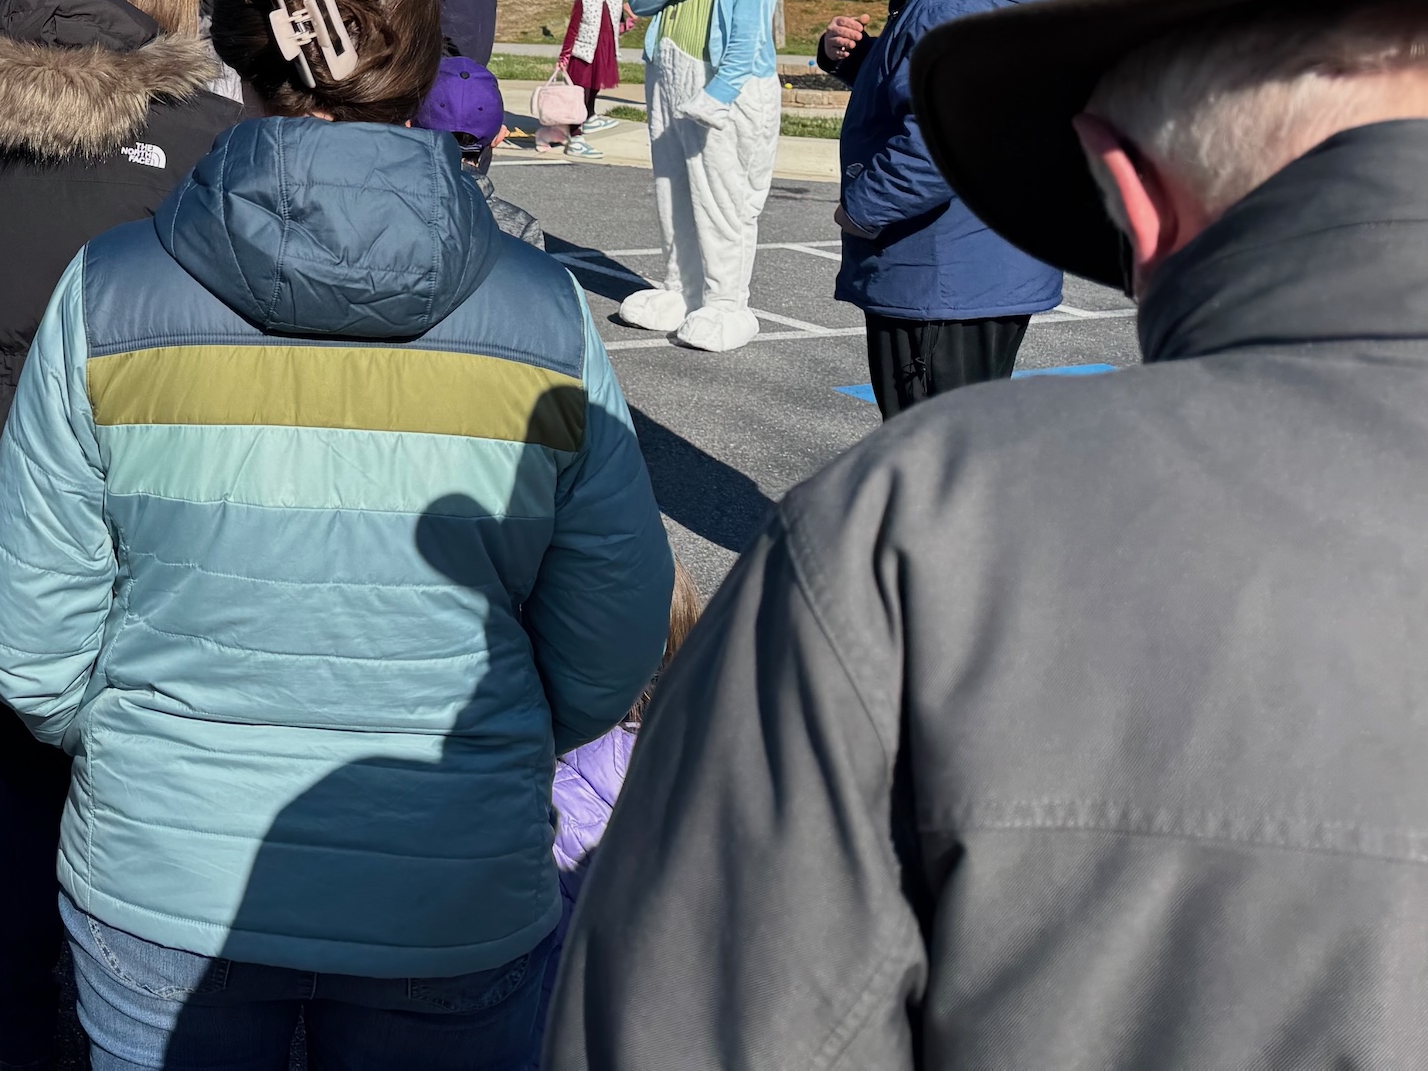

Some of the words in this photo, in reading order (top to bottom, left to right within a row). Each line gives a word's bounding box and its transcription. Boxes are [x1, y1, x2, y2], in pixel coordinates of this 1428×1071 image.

[136, 142, 154, 150] THE
[121, 146, 152, 159] NORTH
[128, 155, 152, 166] FACE
